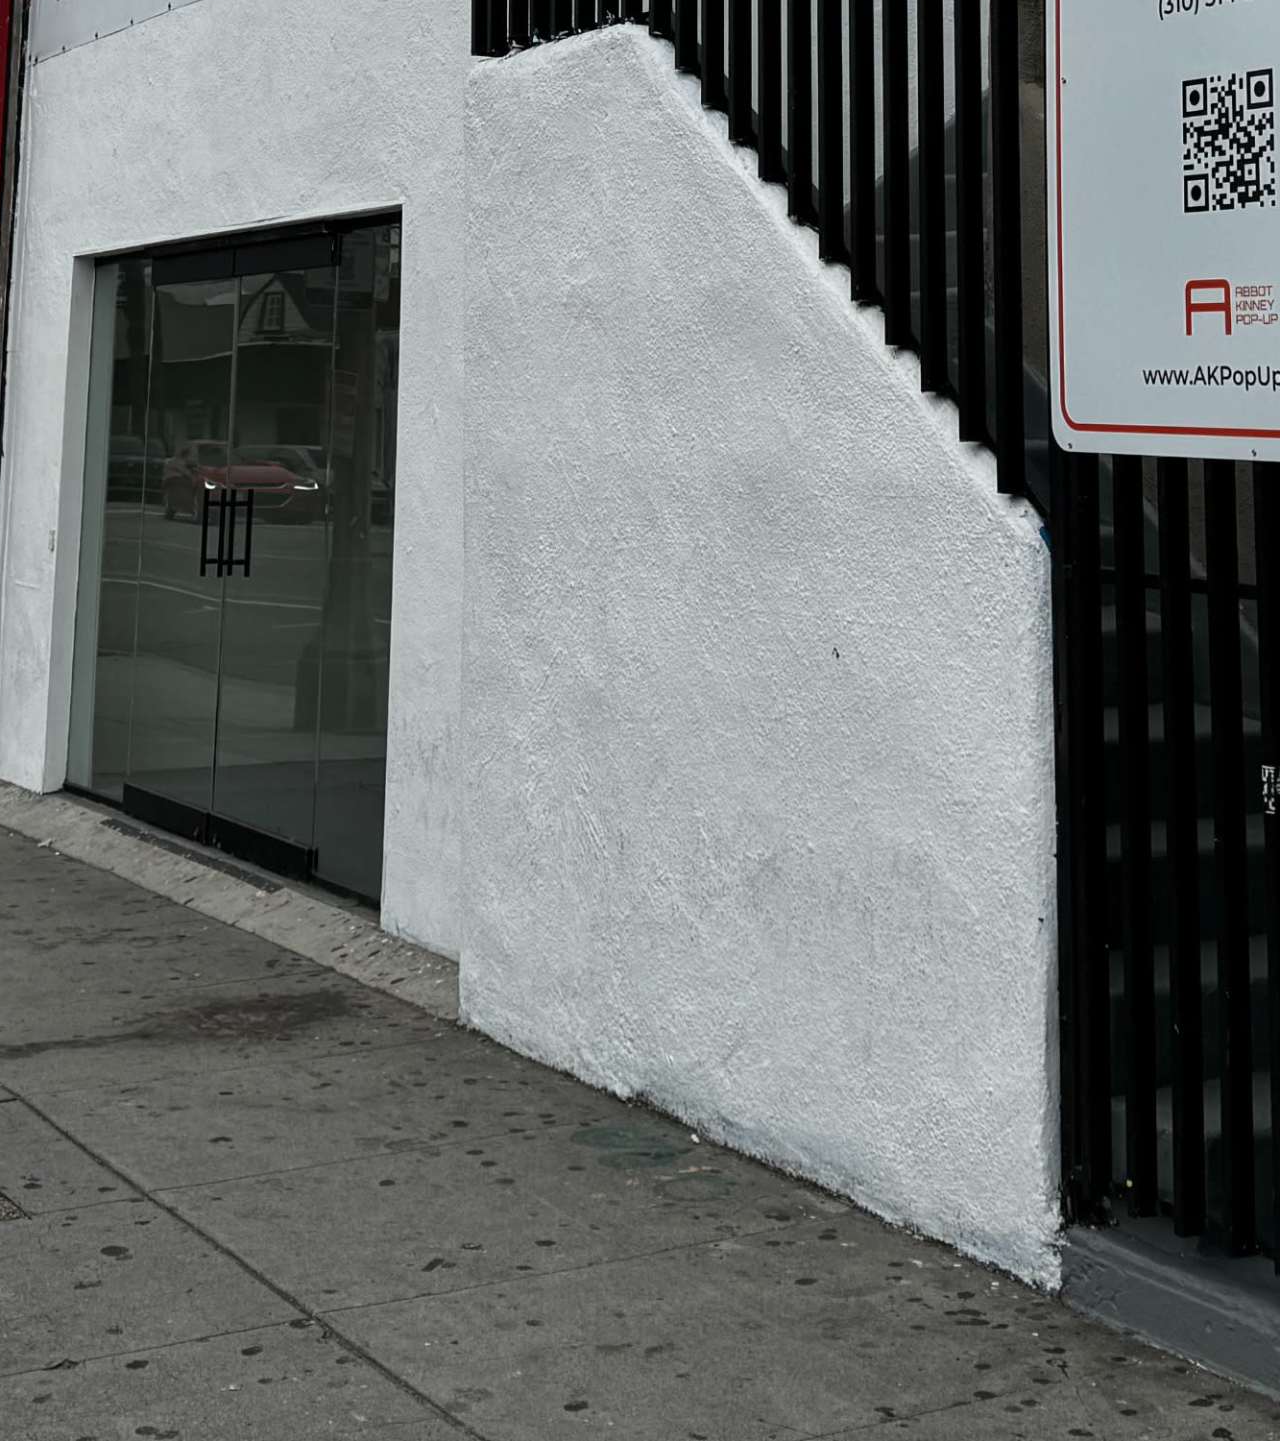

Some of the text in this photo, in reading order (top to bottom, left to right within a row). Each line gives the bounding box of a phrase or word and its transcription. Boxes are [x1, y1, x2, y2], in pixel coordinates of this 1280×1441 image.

[1235, 285, 1272, 298] ABBOT
[1235, 299, 1275, 312] KINNEY
[1235, 313, 1279, 326] POP-UP
